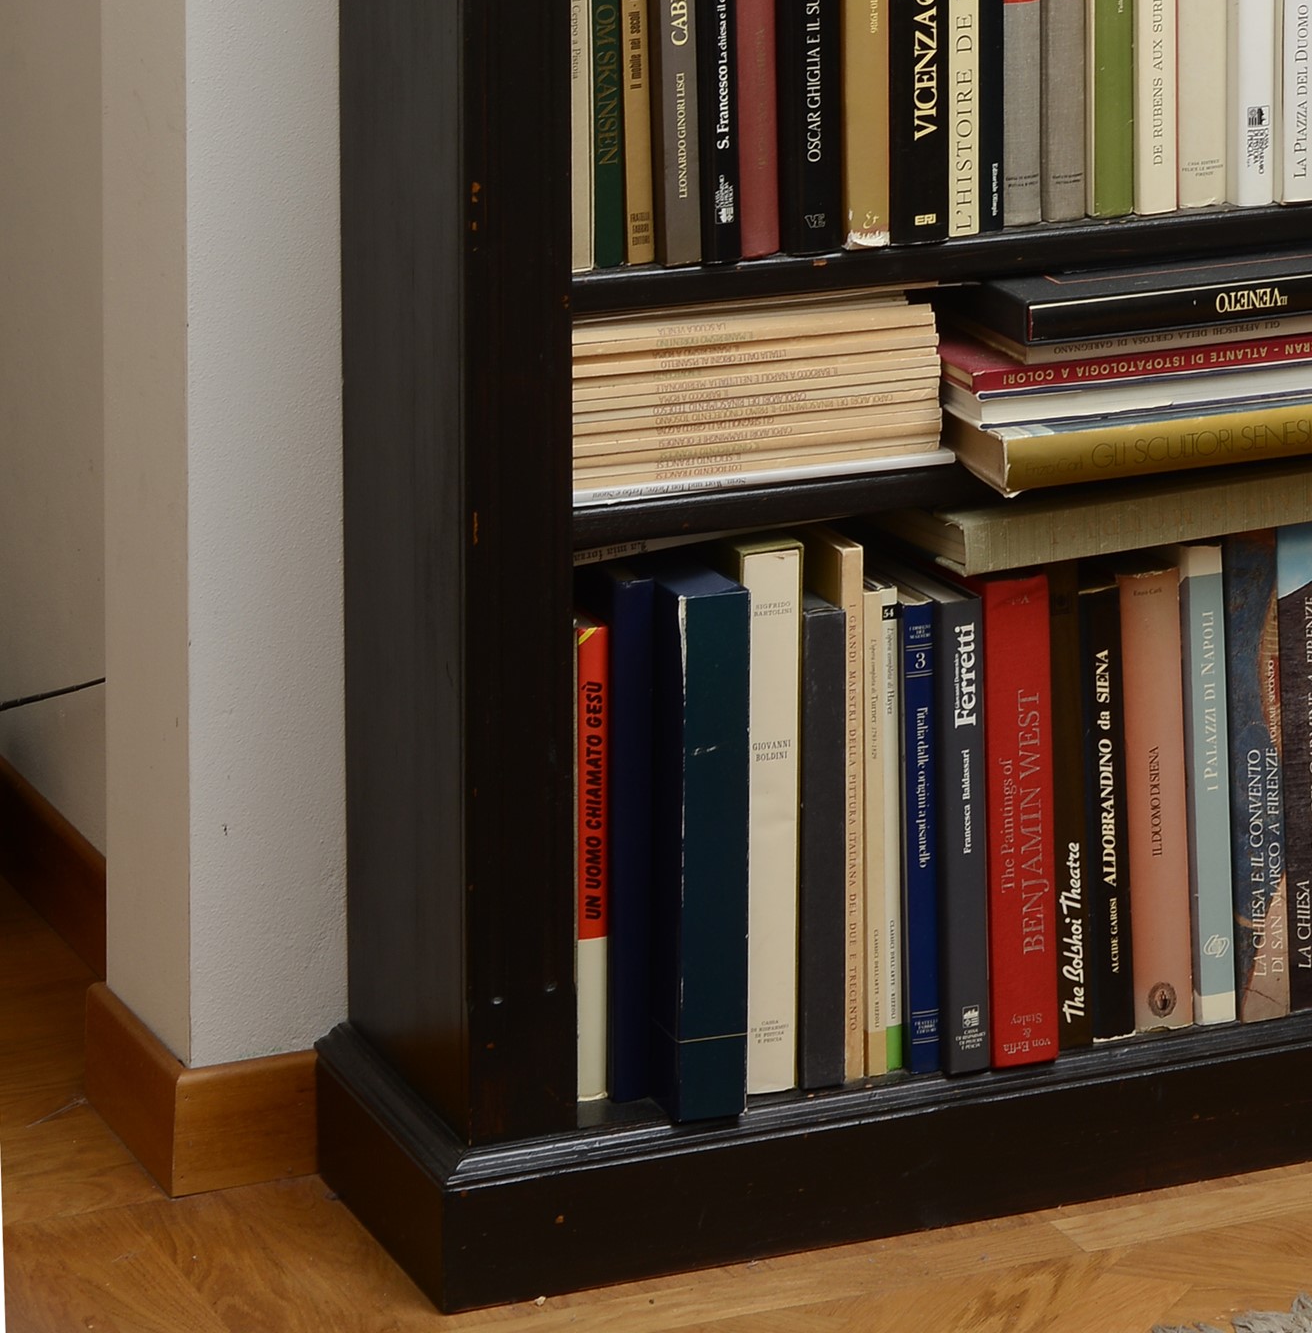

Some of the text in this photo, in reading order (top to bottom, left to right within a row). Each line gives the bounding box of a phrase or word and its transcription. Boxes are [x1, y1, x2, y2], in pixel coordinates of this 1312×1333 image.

[956, 14, 973, 53] DE
[1152, 39, 1163, 70] AUX
[1152, 77, 1163, 140] RUBENS
[956, 68, 974, 231] L'HISTOIRE
[1152, 146, 1163, 165] DE
[1215, 286, 1280, 314] VENETO
[955, 622, 976, 729] Ferretti
[752, 740, 791, 751] GIOVANNI
[755, 751, 788, 761] BOLDINI
[1096, 649, 1117, 888] ALDOBRANDINO da SIENA
[581, 681, 602, 920] UN UOMO CHIAMATO GESÙ
[1017, 690, 1045, 955] BENJAMIN WEST
[1058, 842, 1085, 1024] The Bolshoi Theatre
